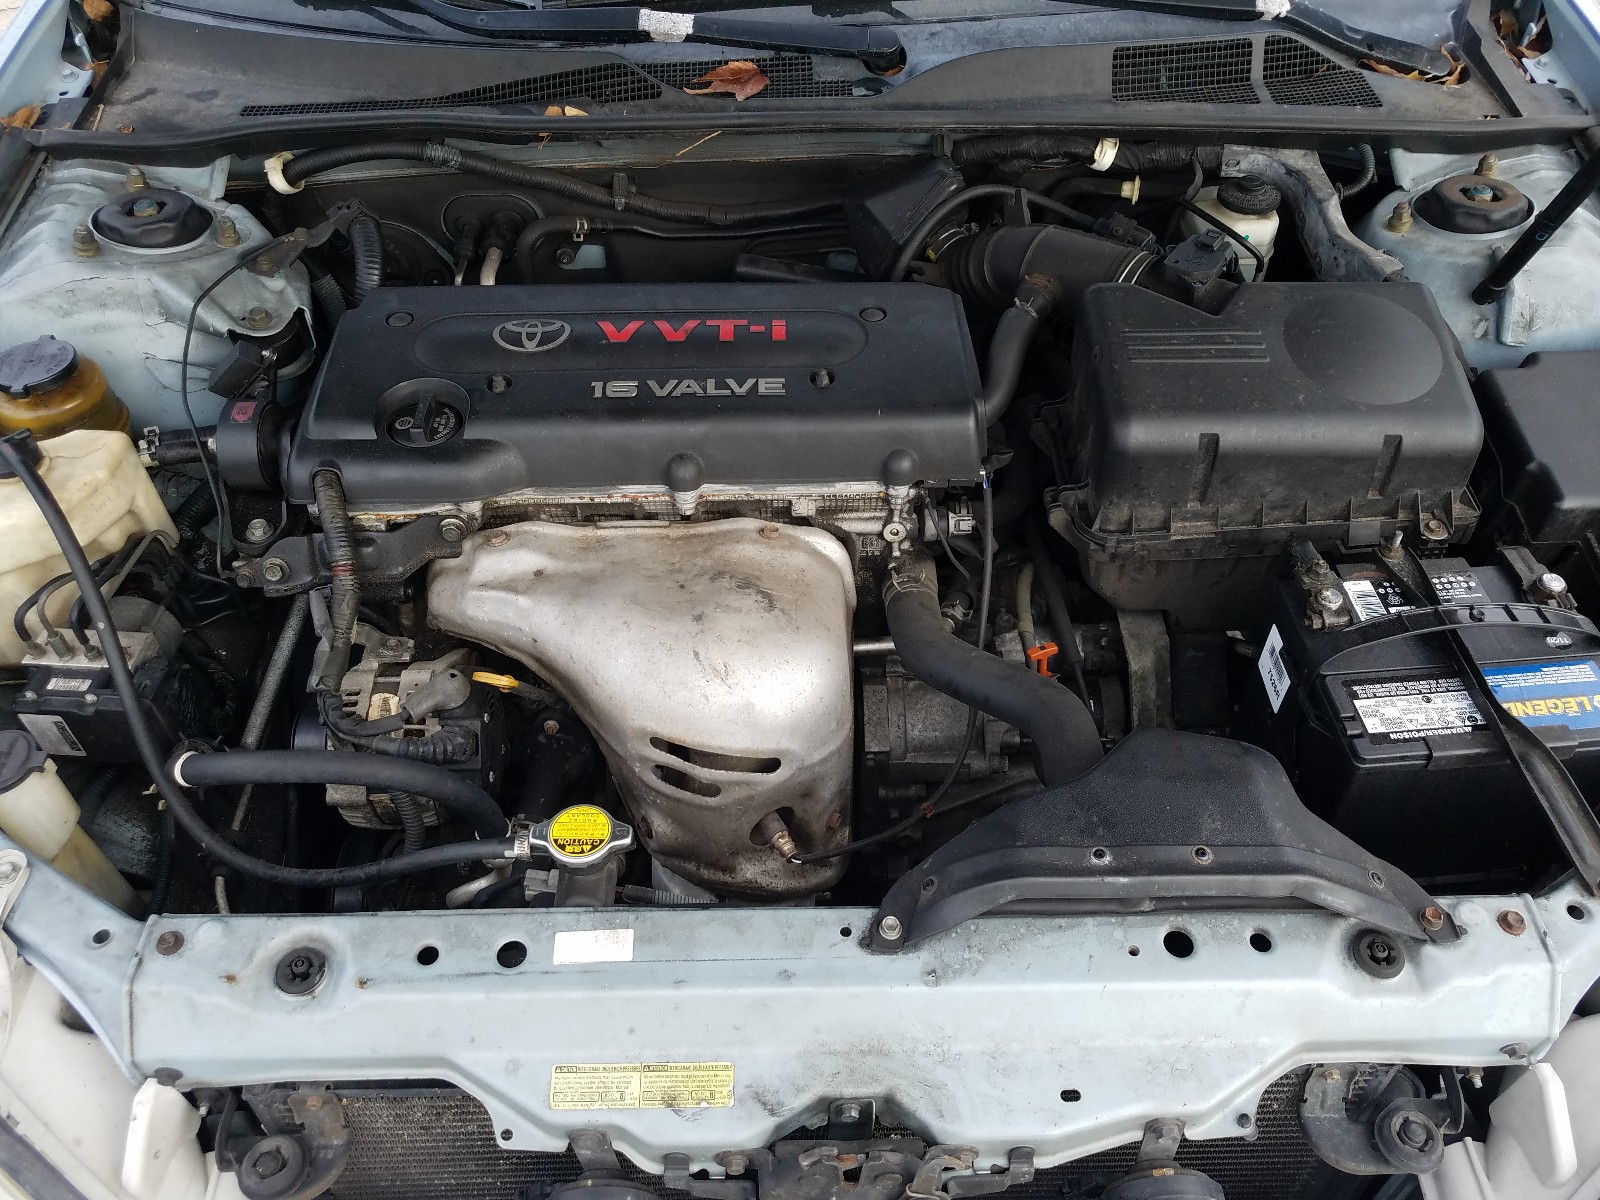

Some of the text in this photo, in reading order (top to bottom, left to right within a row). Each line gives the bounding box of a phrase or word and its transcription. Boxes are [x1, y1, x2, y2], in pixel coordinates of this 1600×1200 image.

[596, 319, 787, 342] VVT-i
[591, 377, 787, 398] 16 VALVE
